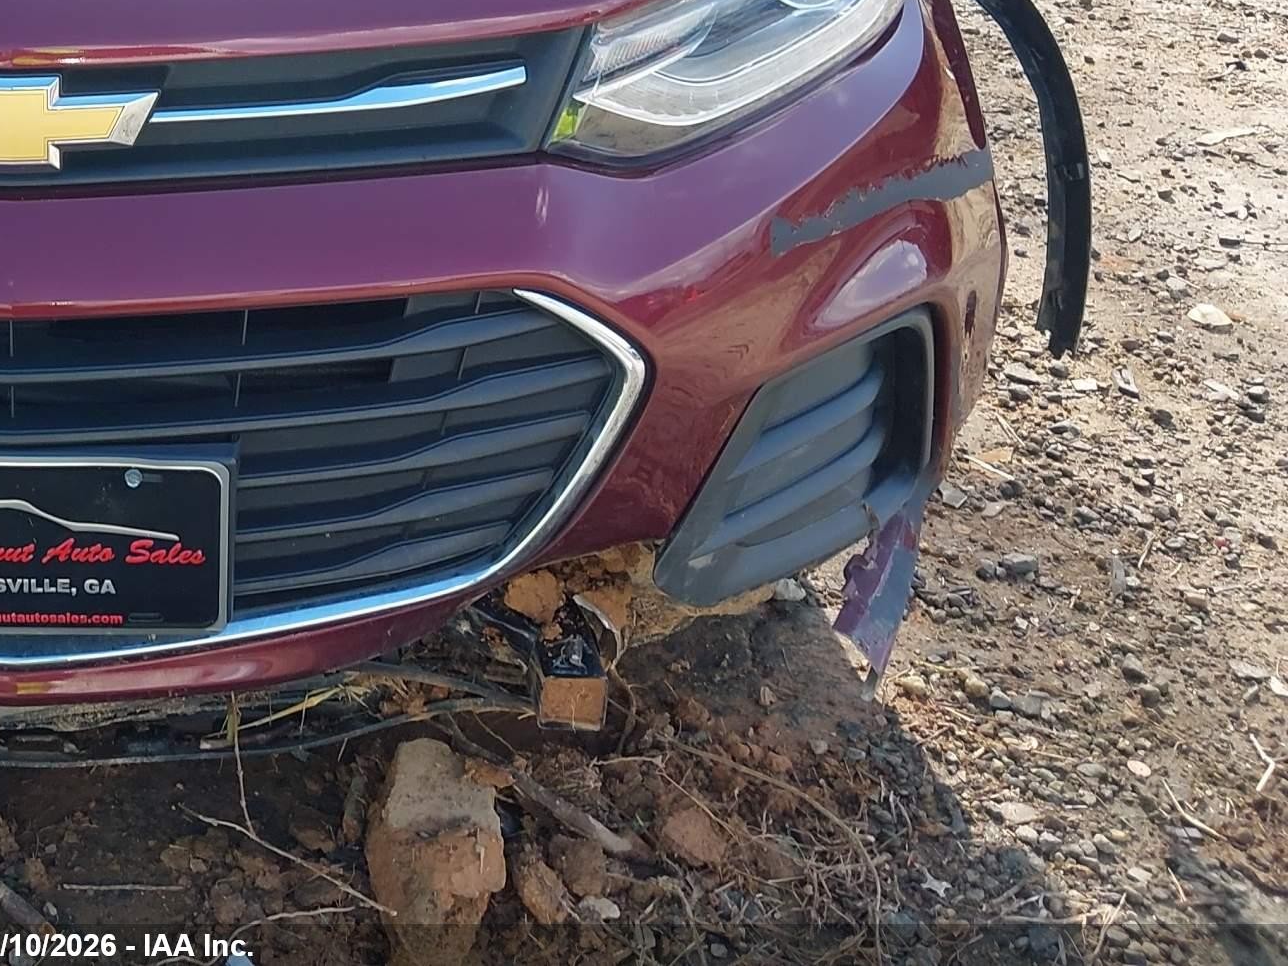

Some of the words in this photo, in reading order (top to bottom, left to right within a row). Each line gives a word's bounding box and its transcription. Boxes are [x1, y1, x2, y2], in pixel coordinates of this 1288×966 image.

[41, 537, 115, 565] Auto
[125, 539, 207, 565] Sales
[84, 578, 117, 595] GA
